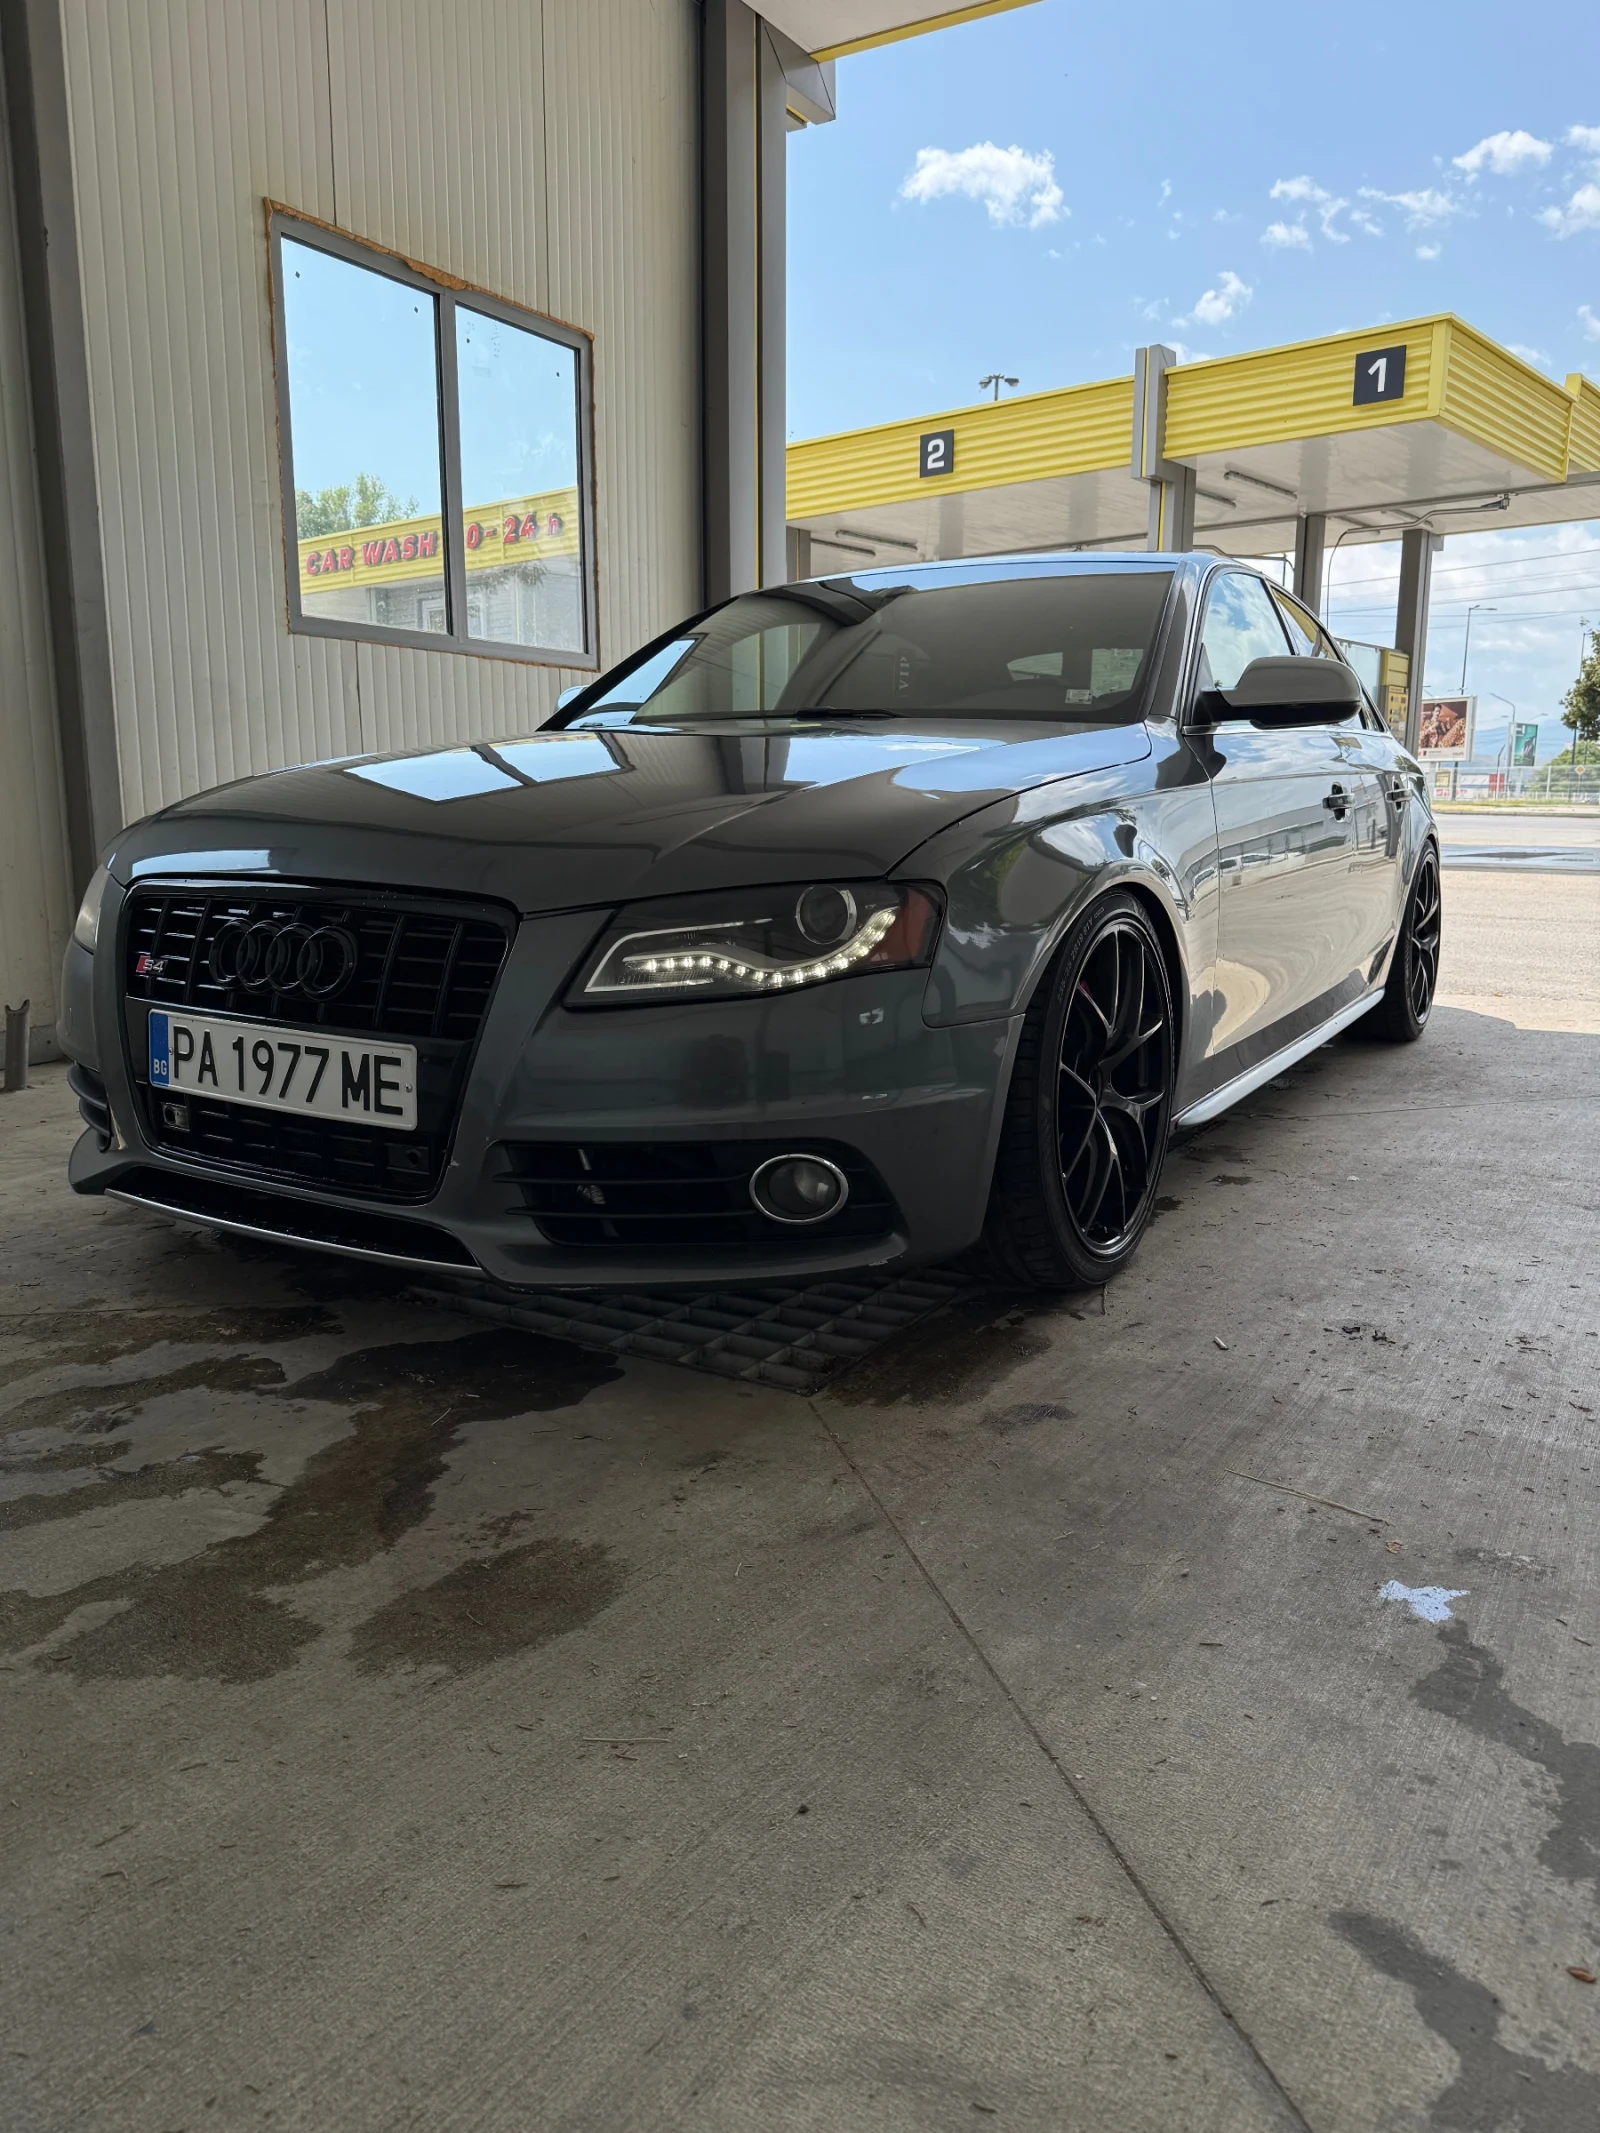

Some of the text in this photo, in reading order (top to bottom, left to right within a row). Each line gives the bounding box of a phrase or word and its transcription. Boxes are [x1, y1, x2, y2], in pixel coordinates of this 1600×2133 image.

[1367, 357, 1387, 393] 1
[927, 437, 945, 470] 2
[305, 546, 353, 575] CAR
[361, 531, 437, 566] WASH
[143, 957, 165, 973] S4
[153, 1058, 167, 1076] BG
[172, 1026, 404, 1116] PA 1977 ME
